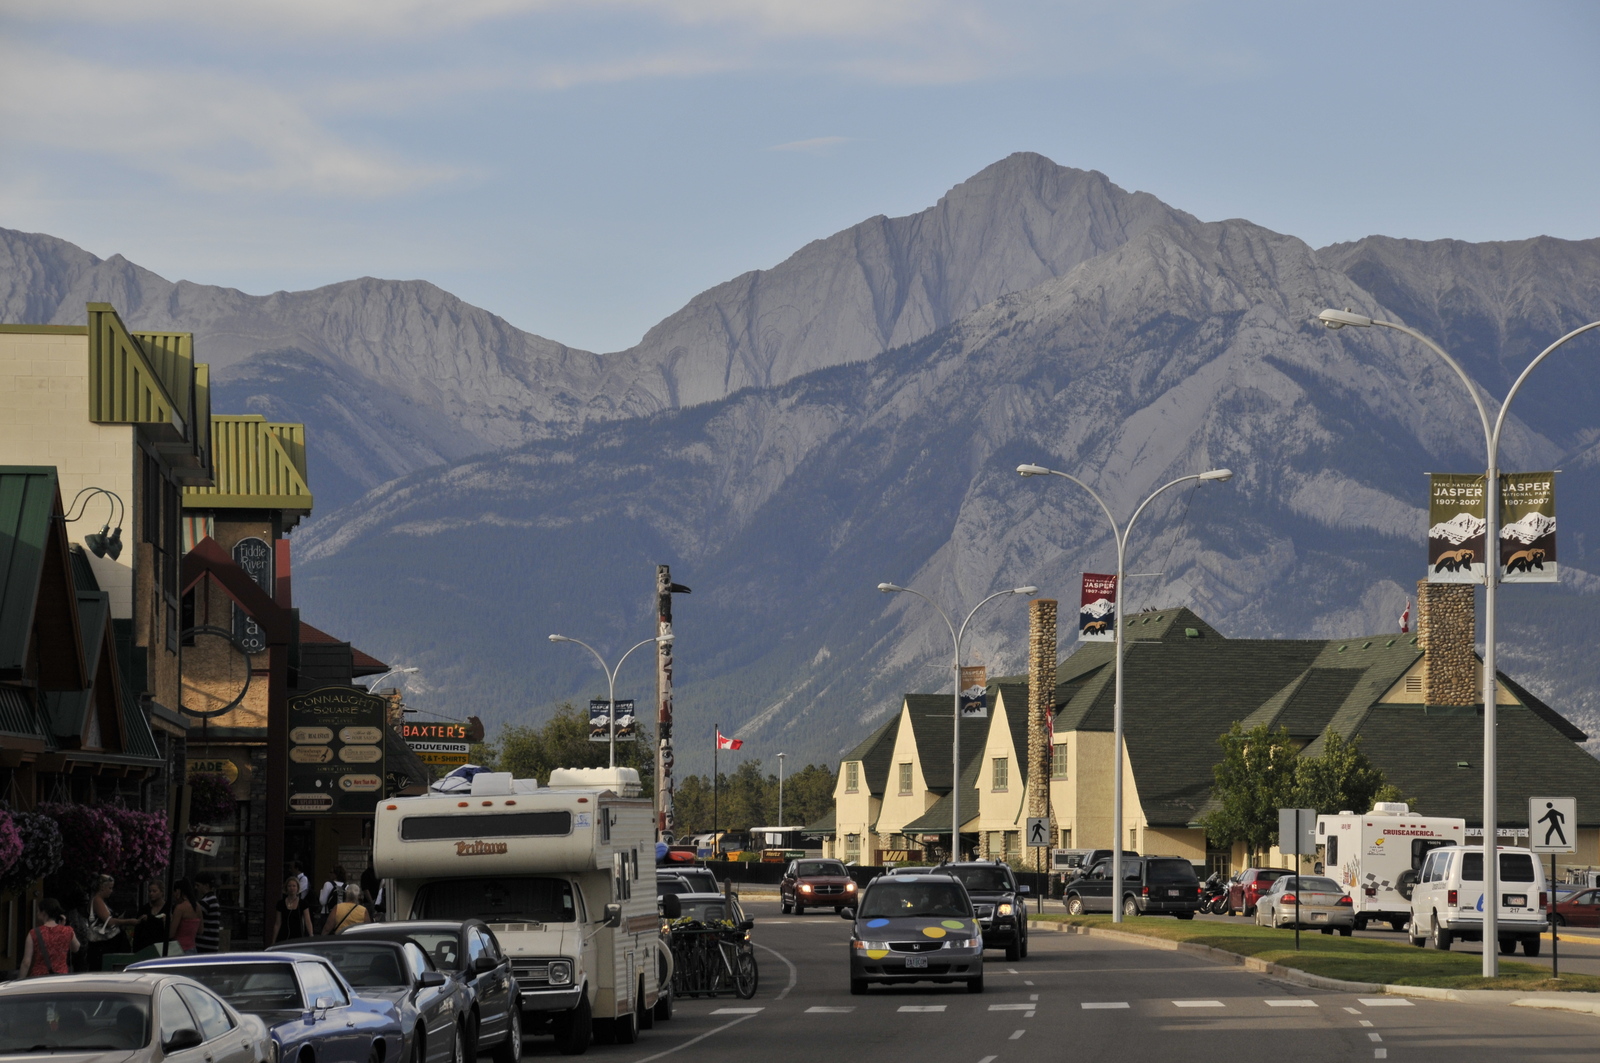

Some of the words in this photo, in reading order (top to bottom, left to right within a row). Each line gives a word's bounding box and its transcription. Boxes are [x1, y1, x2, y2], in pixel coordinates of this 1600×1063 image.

[1502, 482, 1551, 492] JASPER
[1433, 488, 1483, 497] JASPER
[1504, 498, 1549, 506] 1907-2007
[240, 556, 267, 574] River
[292, 694, 379, 711] CONNAUGHT
[313, 706, 359, 715] SQUARE
[403, 724, 466, 739] BAXTER'S
[408, 743, 466, 751] SOUVENIRS
[191, 762, 223, 771] JADE
[1382, 829, 1434, 837] CRUISEAMERICA
[882, 850, 908, 862] VIA
